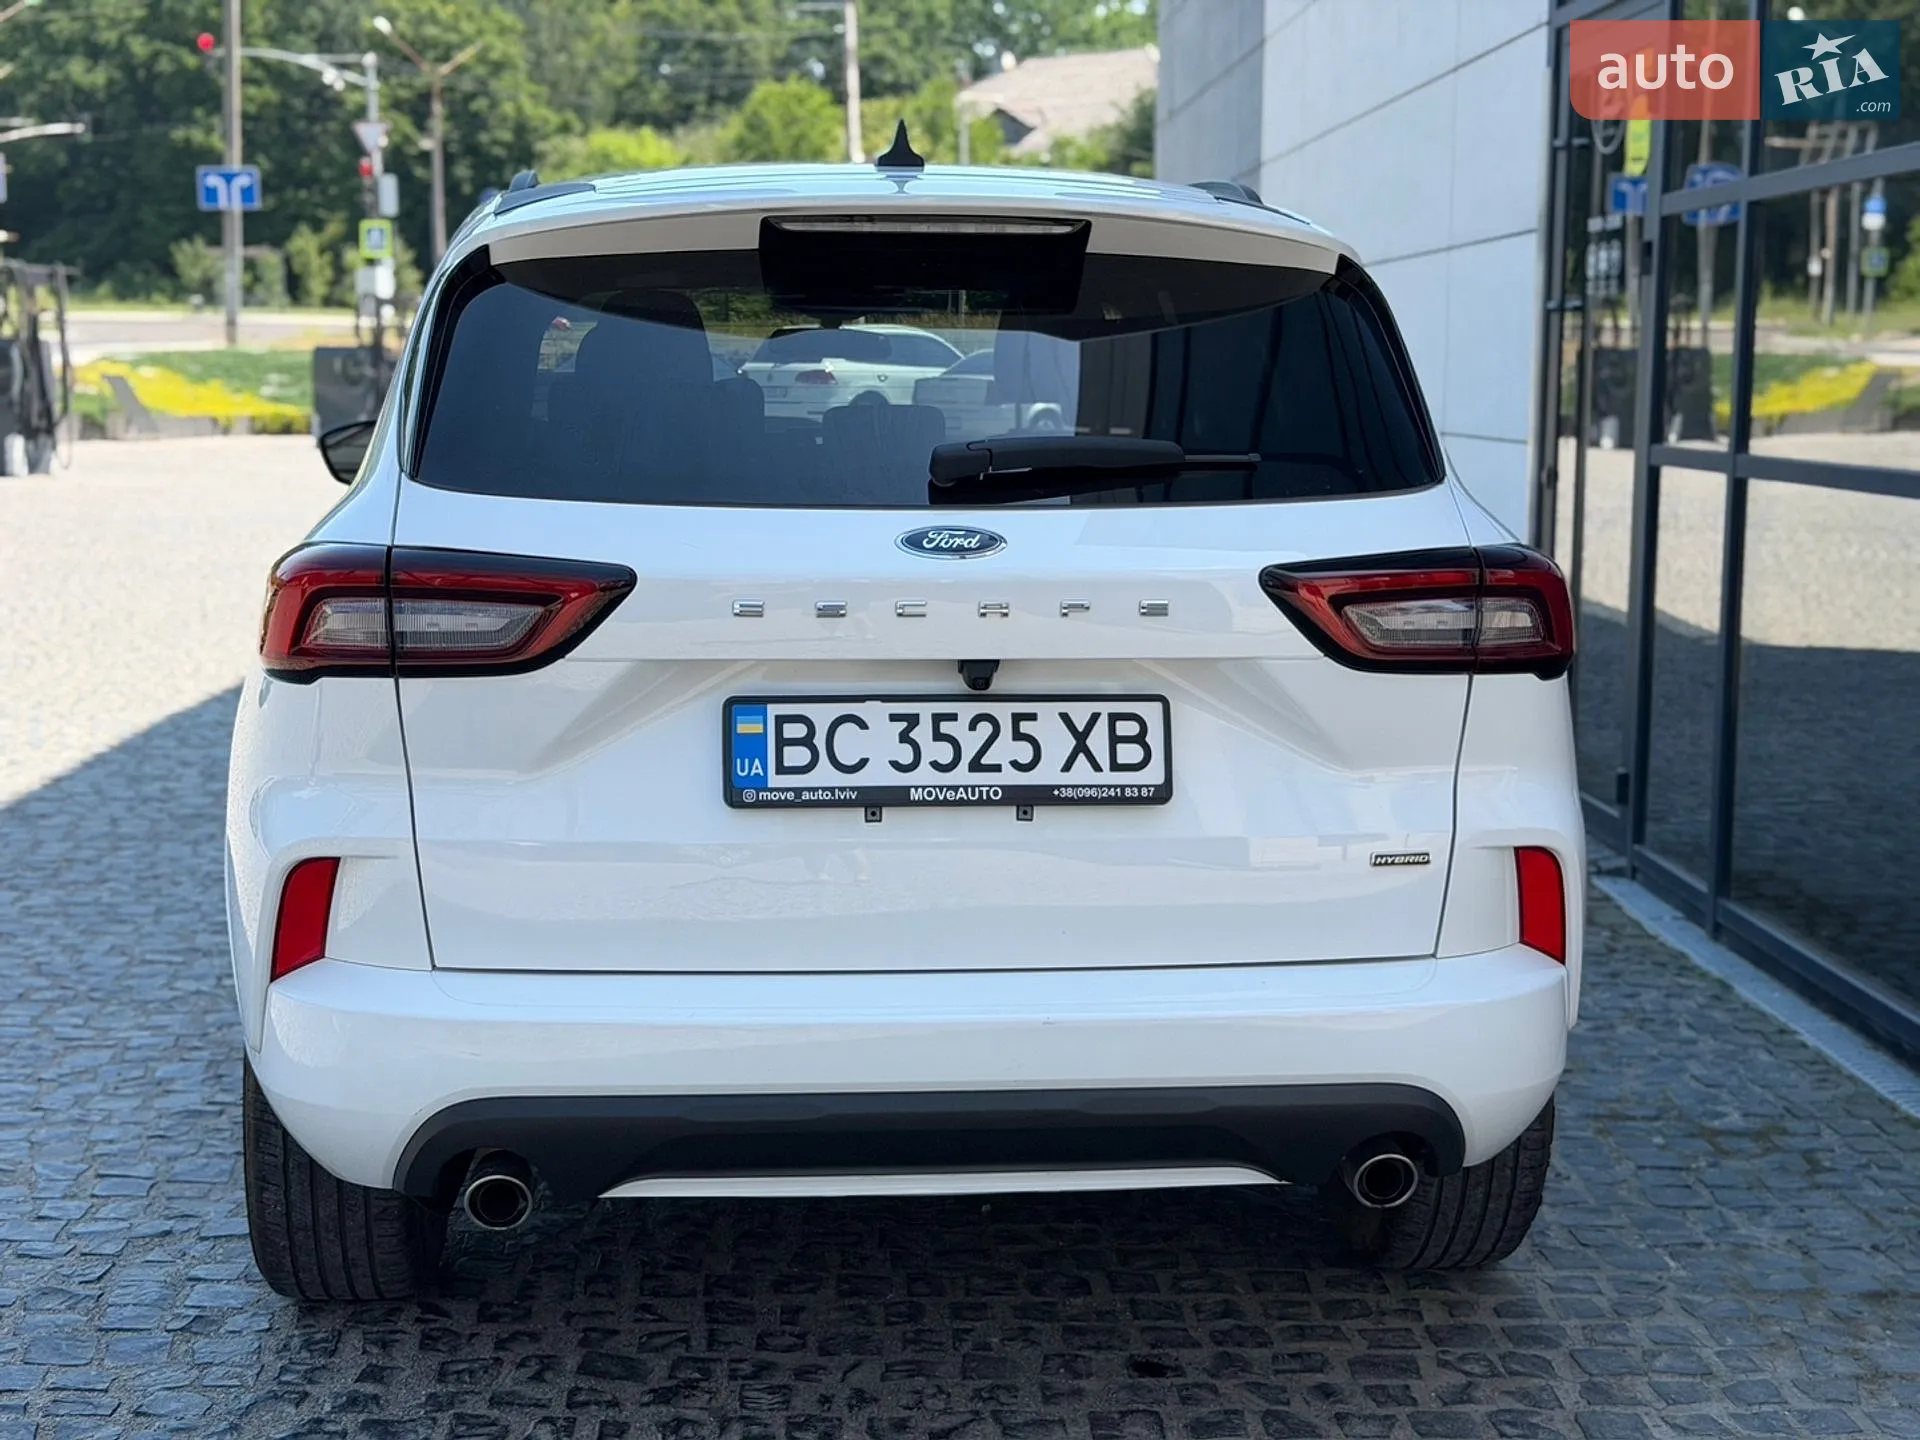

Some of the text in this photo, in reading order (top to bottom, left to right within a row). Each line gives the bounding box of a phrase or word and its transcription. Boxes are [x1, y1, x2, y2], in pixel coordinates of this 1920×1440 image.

[922, 530, 981, 549] Ford
[732, 600, 1169, 617] ESCAPE
[774, 711, 1152, 775] BC 3525 XB
[736, 757, 764, 777] UA
[758, 789, 858, 803] move_auto.lviv
[909, 786, 1003, 801] MOVeAUTO
[1124, 787, 1139, 797] 83
[1140, 787, 1155, 797] 87
[1375, 854, 1429, 865] HYBRID
